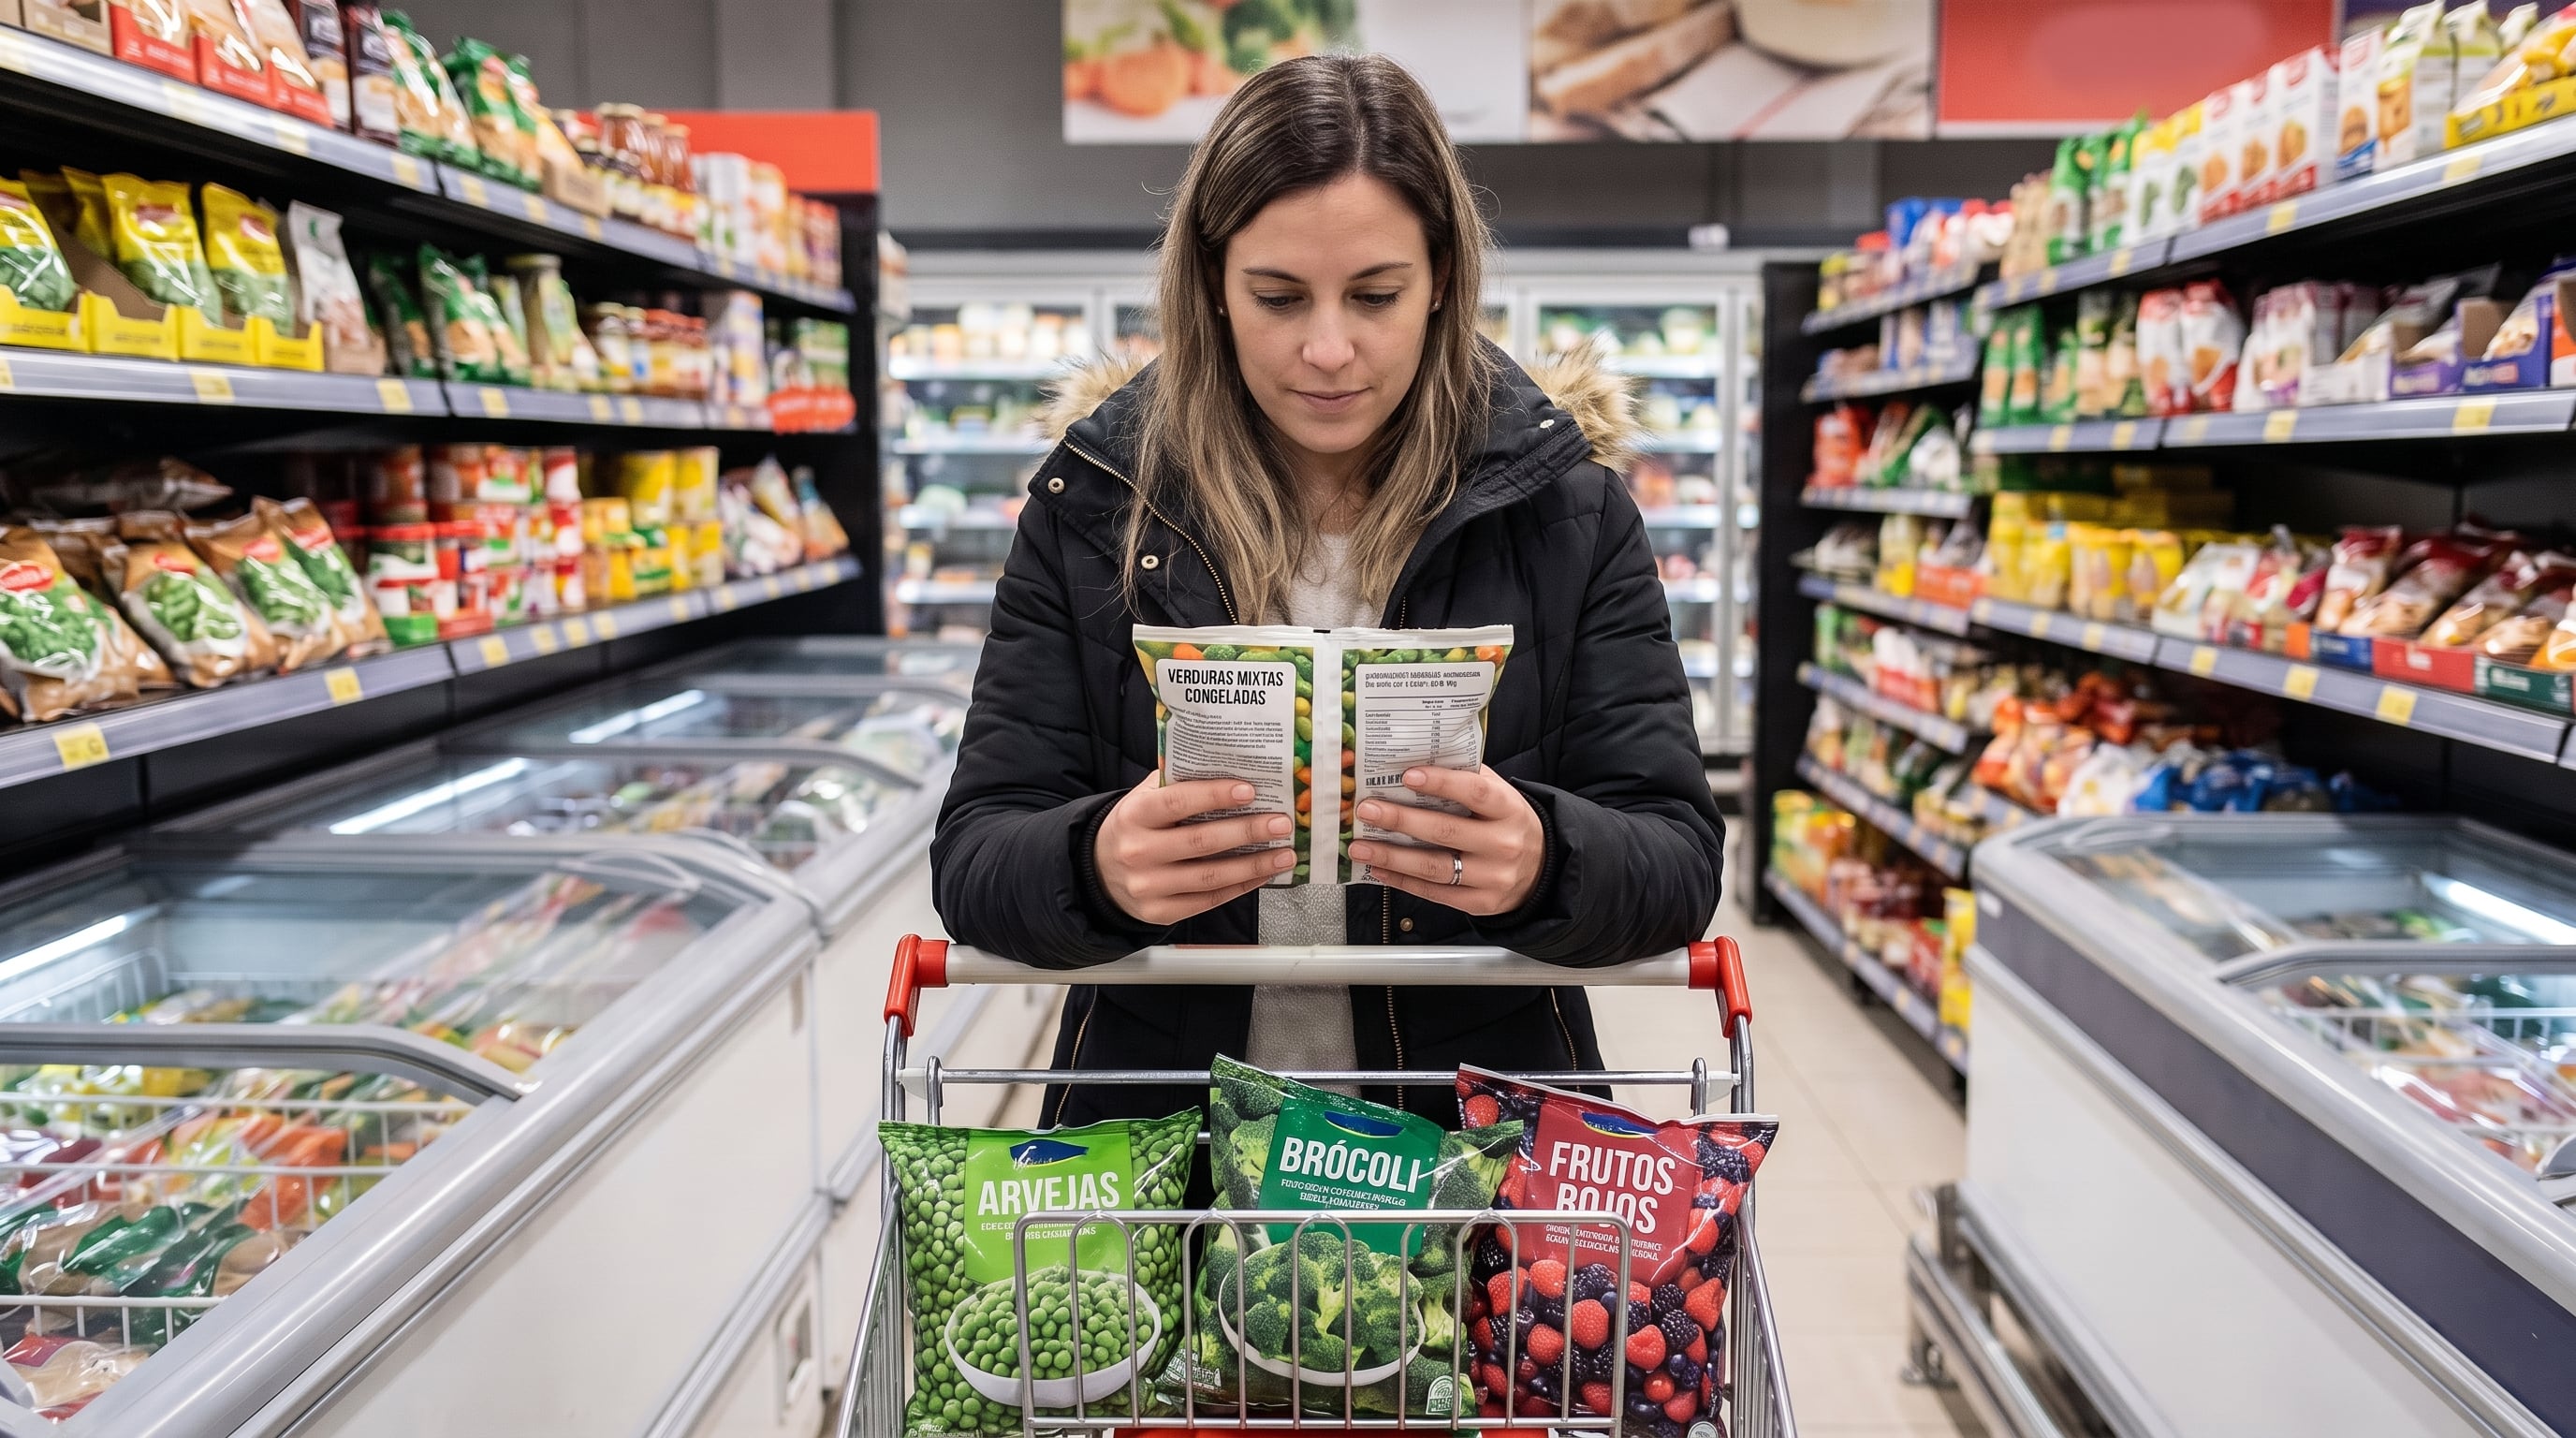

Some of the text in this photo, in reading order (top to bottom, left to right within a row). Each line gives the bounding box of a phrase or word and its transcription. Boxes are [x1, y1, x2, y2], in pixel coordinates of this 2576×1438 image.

[1167, 668, 1284, 687] VERDURAS MIXTAS
[1185, 688, 1266, 705] CONGELADAS
[1279, 1137, 1421, 1194] BRÓCOLI
[1549, 1140, 1676, 1196] FRUTOS
[977, 1171, 1120, 1216] ARVEJAS
